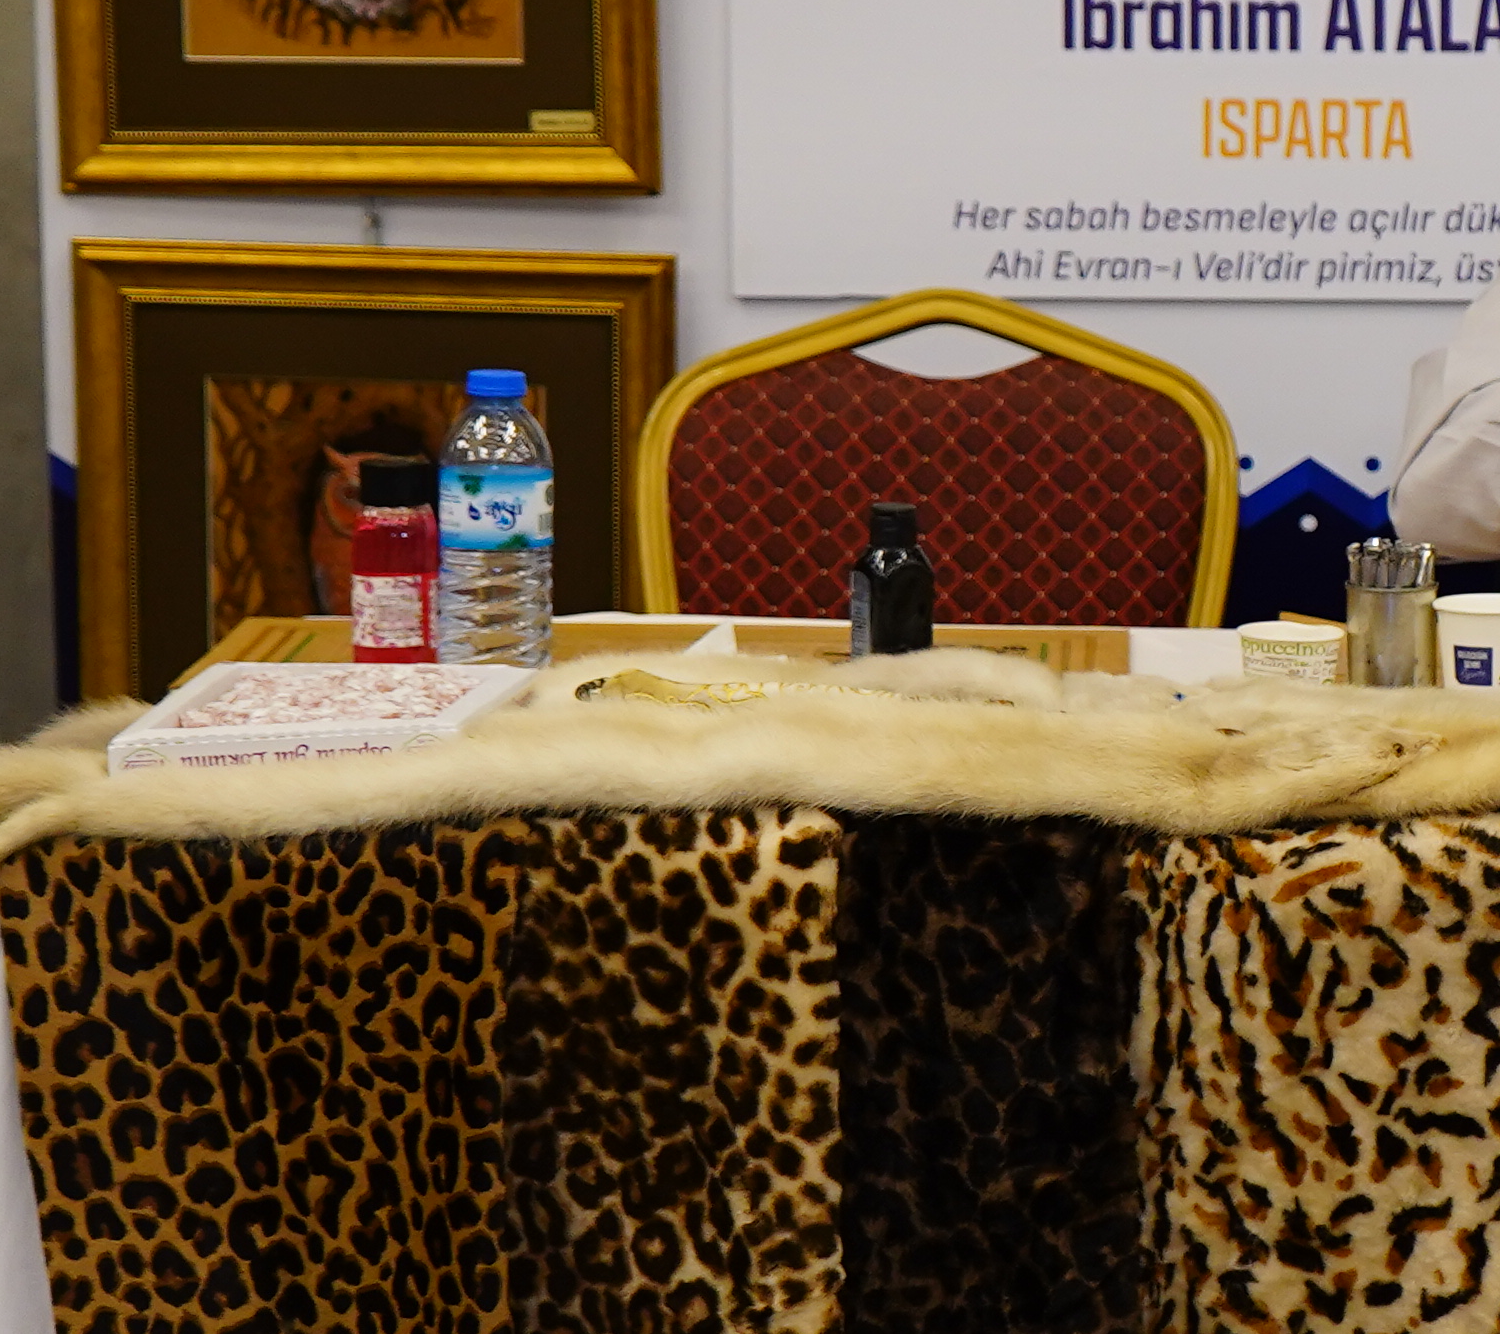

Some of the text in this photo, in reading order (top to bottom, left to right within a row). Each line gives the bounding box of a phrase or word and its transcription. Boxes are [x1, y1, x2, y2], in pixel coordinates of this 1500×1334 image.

[1202, 98, 1413, 161] ISPARTA
[953, 201, 1016, 232] Her
[1025, 201, 1130, 232] sabah
[1142, 202, 1338, 239] besmeleyle
[1348, 202, 1436, 241] açılır
[986, 250, 1044, 279] Ahi
[1053, 251, 1182, 280] Evran-ı
[1316, 252, 1442, 289] pirimiz,
